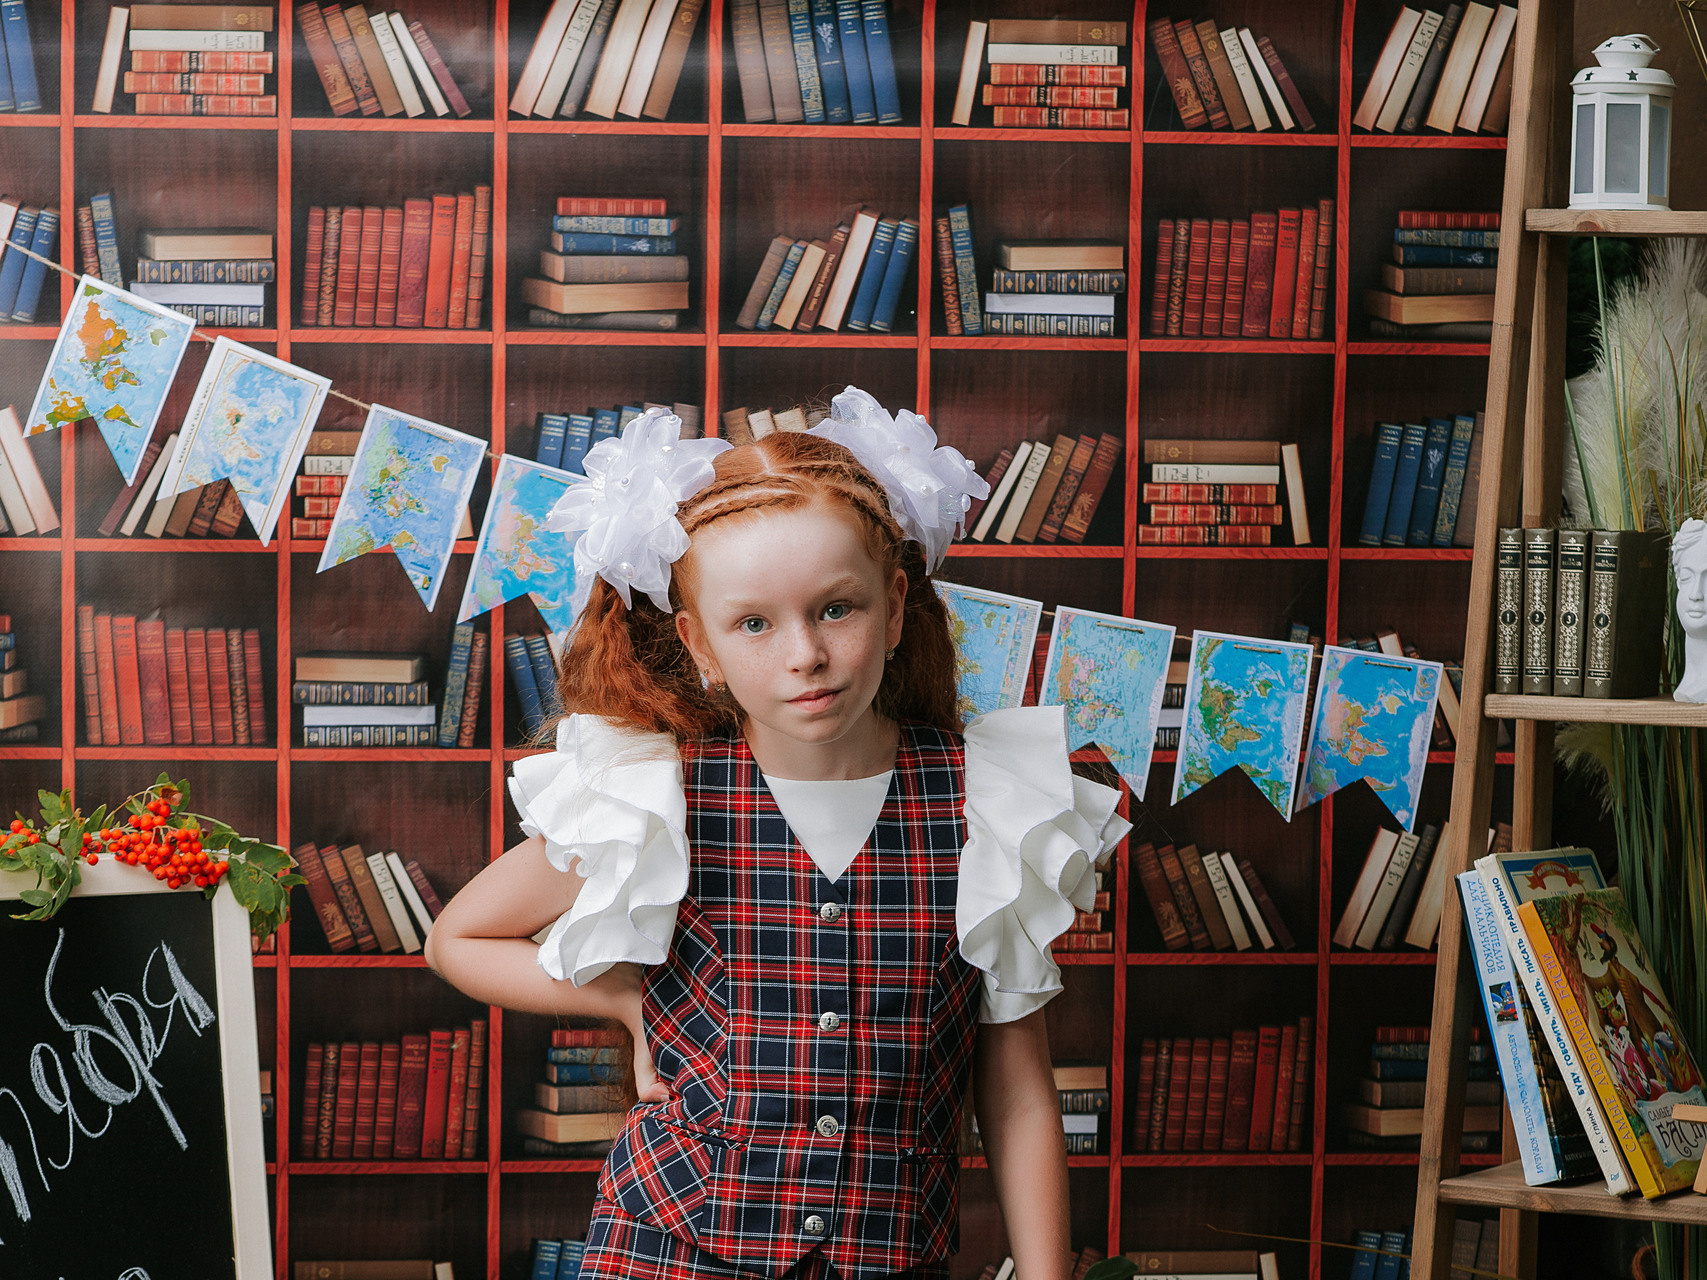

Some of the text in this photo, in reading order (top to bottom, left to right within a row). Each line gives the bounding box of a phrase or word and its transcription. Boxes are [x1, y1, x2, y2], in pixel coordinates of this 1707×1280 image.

[1534, 613, 1540, 622] 2
[1566, 615, 1572, 625] 3
[1466, 880, 1496, 975] ДЛЯ МАЛЬЧИКОВ
[1491, 877, 1585, 1096] БУДУ ГОВОРИТЬ, ЧИТАТЬ, ПИСАТЬ ПРАВИЛЬНО
[1542, 950, 1637, 1153] САМЫЕ ЛЮБИМЫЕ БАСНИ
[1507, 1032, 1544, 1175] АВТОМОБИЛИ САМОЛЕТЫ КОРАБЛИ
[1586, 1106, 1602, 1136] ГЛИНКА
